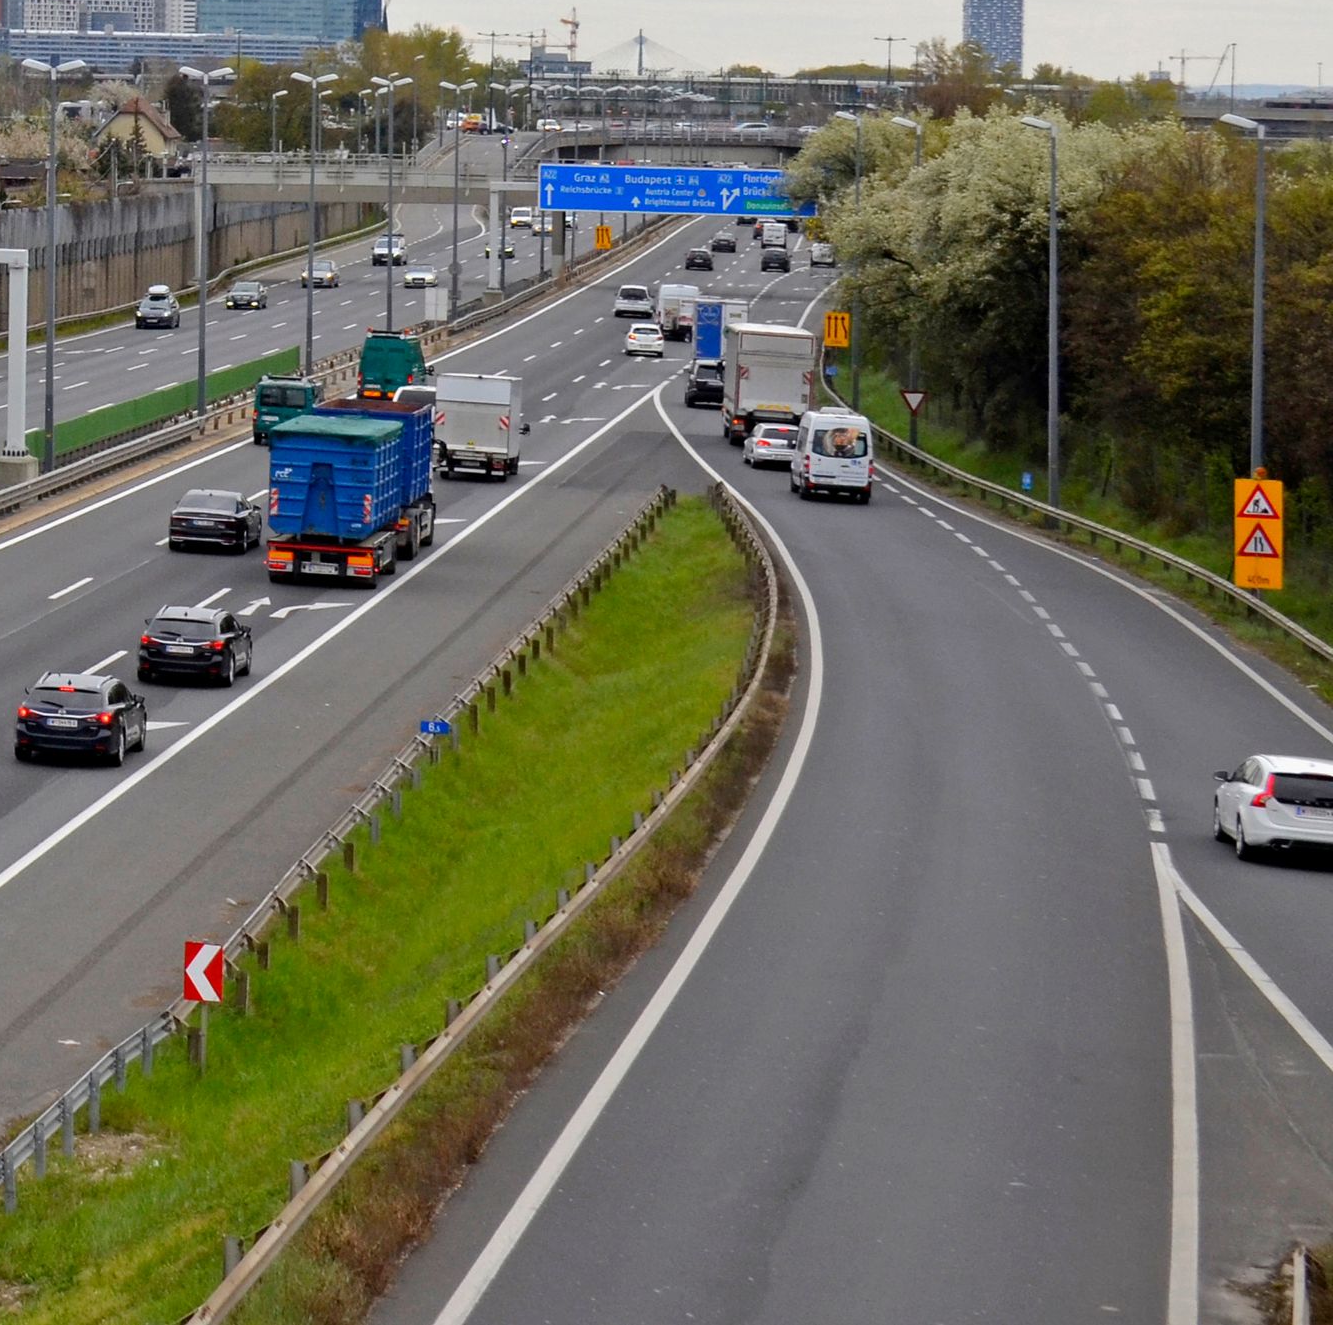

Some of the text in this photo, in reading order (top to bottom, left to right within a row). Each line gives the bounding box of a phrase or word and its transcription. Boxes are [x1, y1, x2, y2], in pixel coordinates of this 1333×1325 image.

[574, 173, 596, 183] Graz
[624, 174, 672, 185] Budapest
[560, 185, 612, 195] Reichsbrücke
[645, 188, 694, 196] Austria Center
[644, 198, 716, 207] Brigittenauer Brücke
